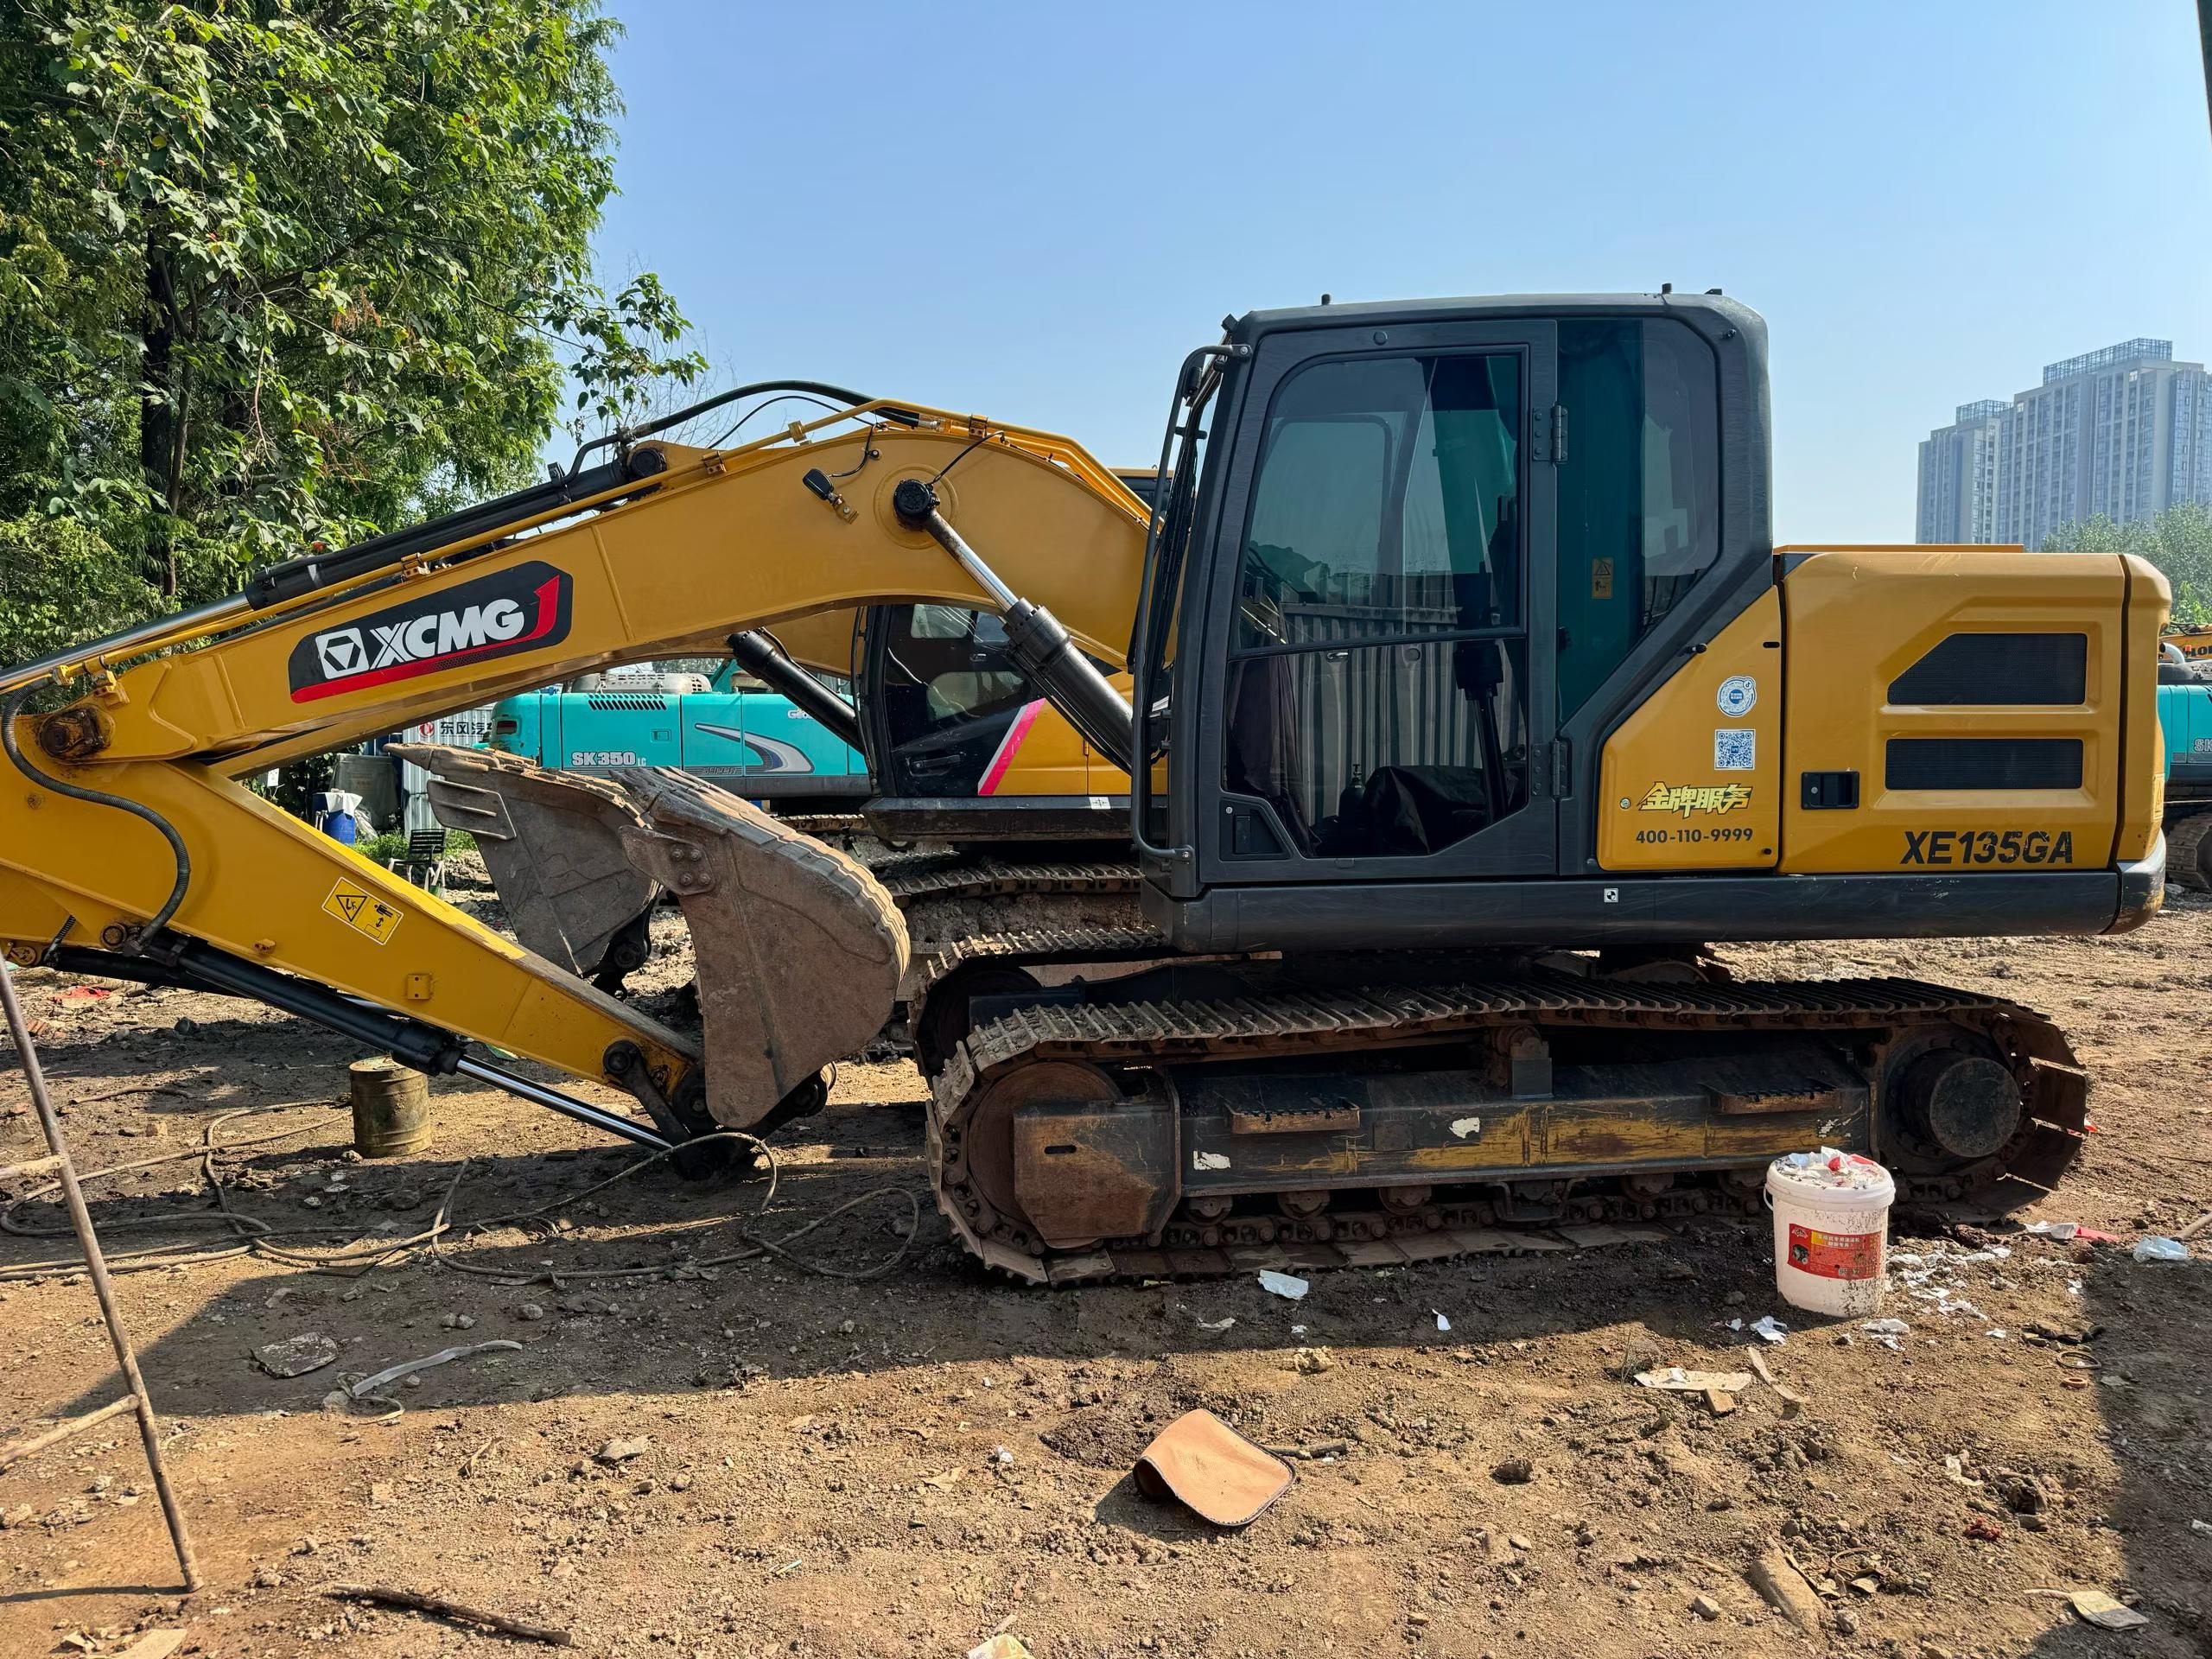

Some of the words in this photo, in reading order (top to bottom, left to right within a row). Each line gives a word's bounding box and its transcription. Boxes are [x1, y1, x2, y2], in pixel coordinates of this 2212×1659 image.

[370, 598, 525, 670] XCMG
[571, 751, 636, 766] SK350
[1637, 781, 1753, 819] 金牌服务
[1636, 828, 1753, 843] 400-110-9999
[1901, 830, 2073, 864] XE135GA
